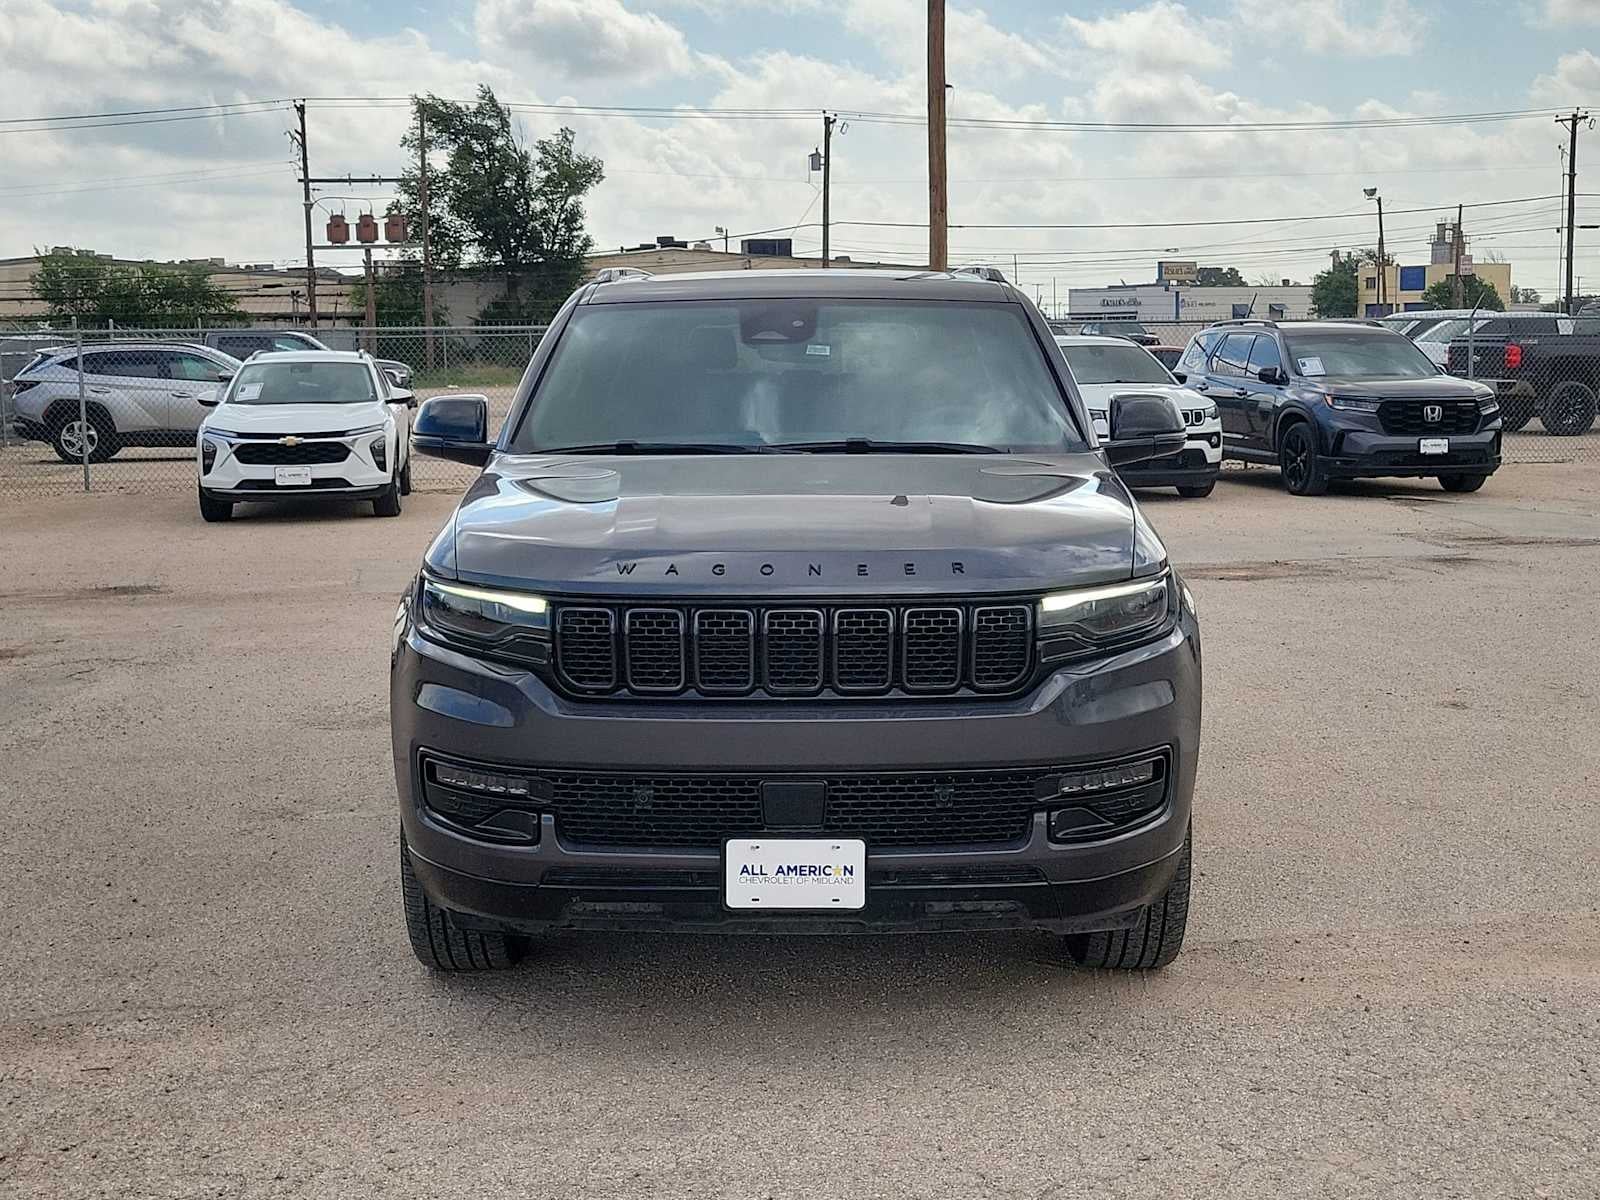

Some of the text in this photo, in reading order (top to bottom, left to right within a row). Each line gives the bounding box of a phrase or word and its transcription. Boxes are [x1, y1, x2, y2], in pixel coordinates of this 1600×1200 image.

[616, 562, 966, 577] WAGONEER
[740, 864, 768, 876] ALL
[739, 876, 854, 885] CHEVROLET OF MIDLAND
